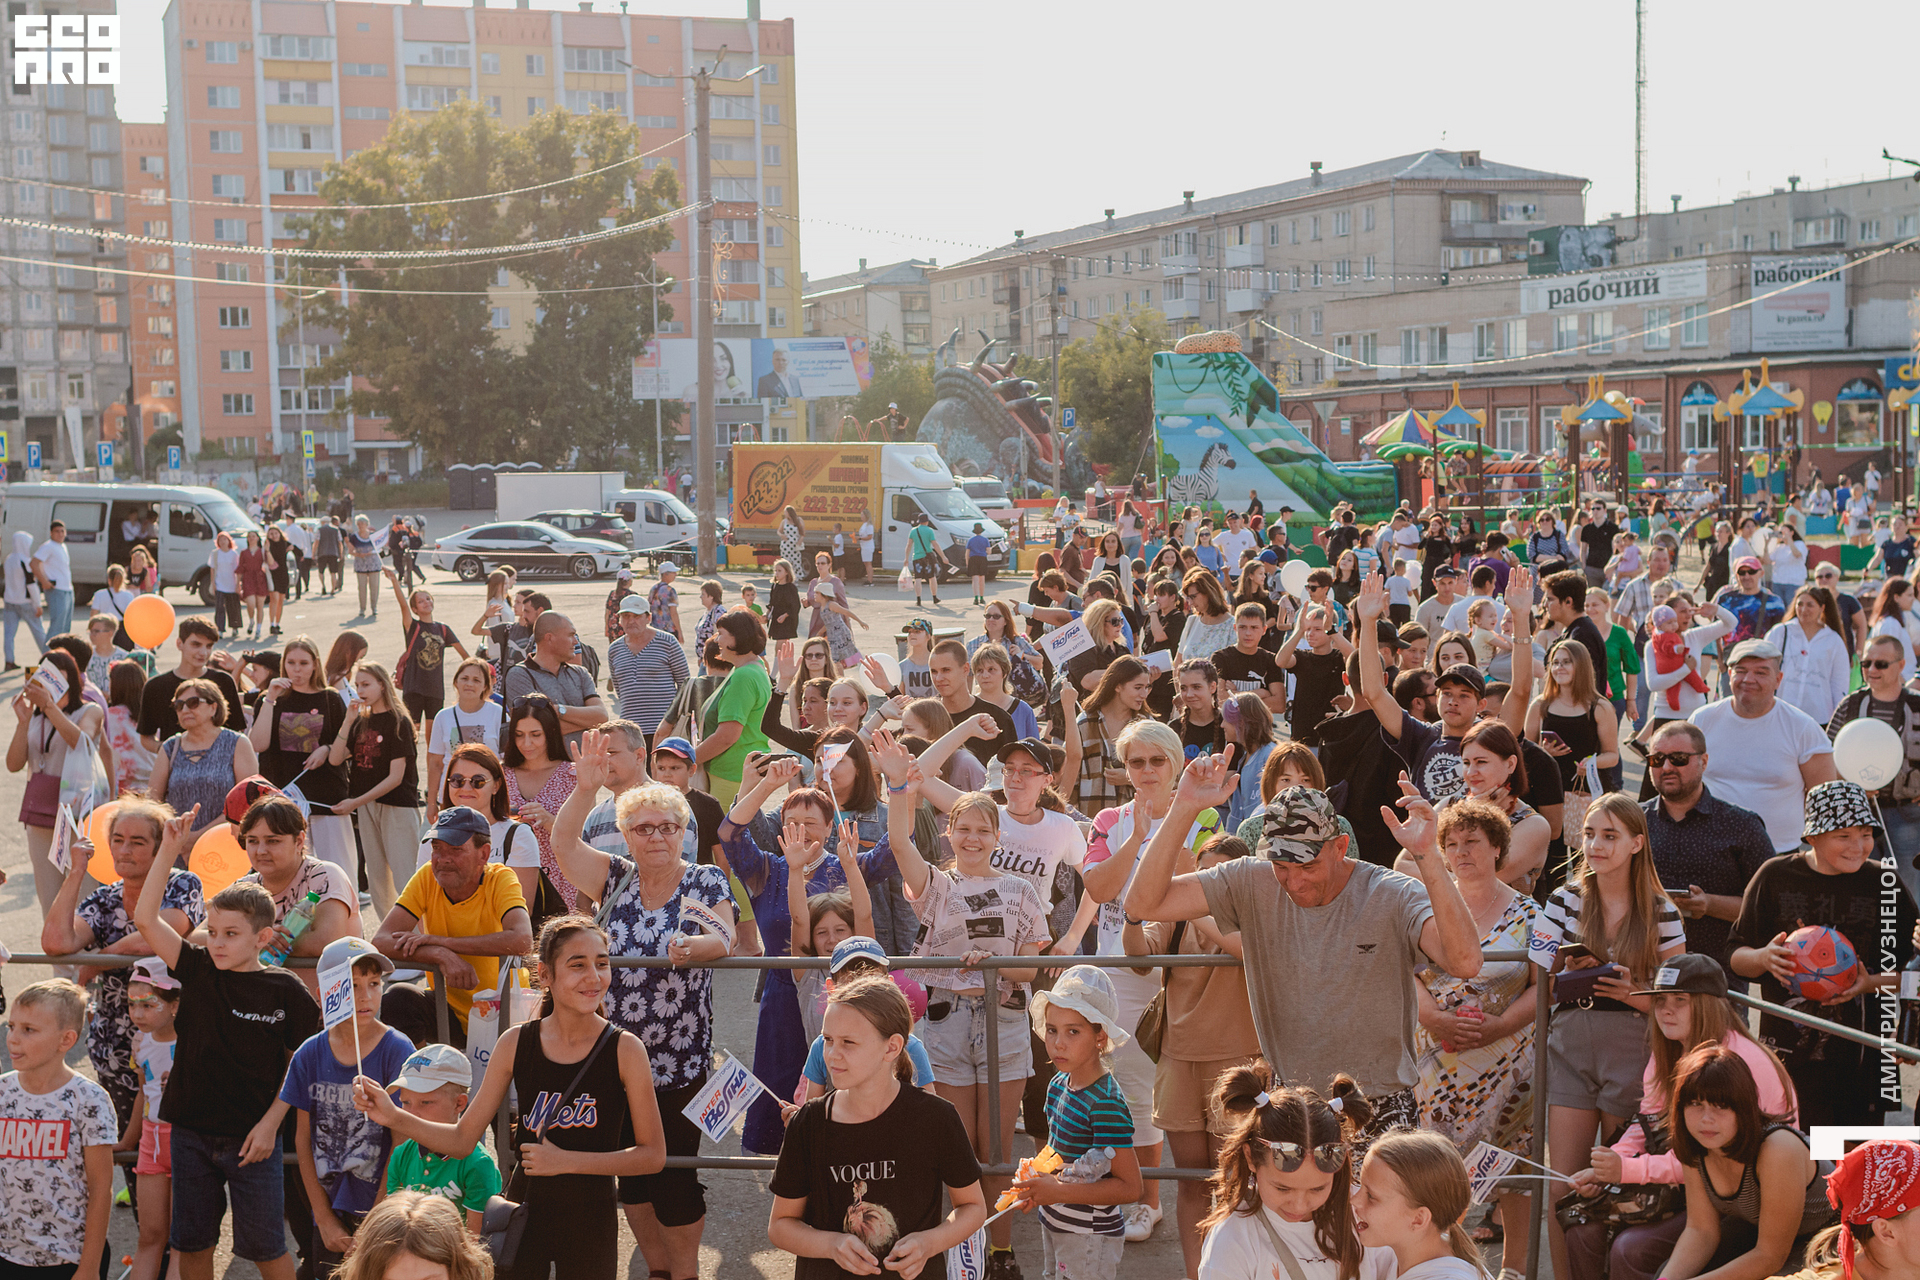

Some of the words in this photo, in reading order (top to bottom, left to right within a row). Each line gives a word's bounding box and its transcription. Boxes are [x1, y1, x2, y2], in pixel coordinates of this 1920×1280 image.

[1547, 268, 1661, 310] рабочий
[743, 460, 793, 515] 222-2-222
[803, 495, 868, 514] 222-2-222
[990, 847, 1048, 878] Bitch
[1017, 844, 1048, 856] ALWAYS
[523, 1091, 598, 1132] Mets
[699, 1089, 721, 1124] INTER
[829, 1160, 896, 1184] VOGUE
